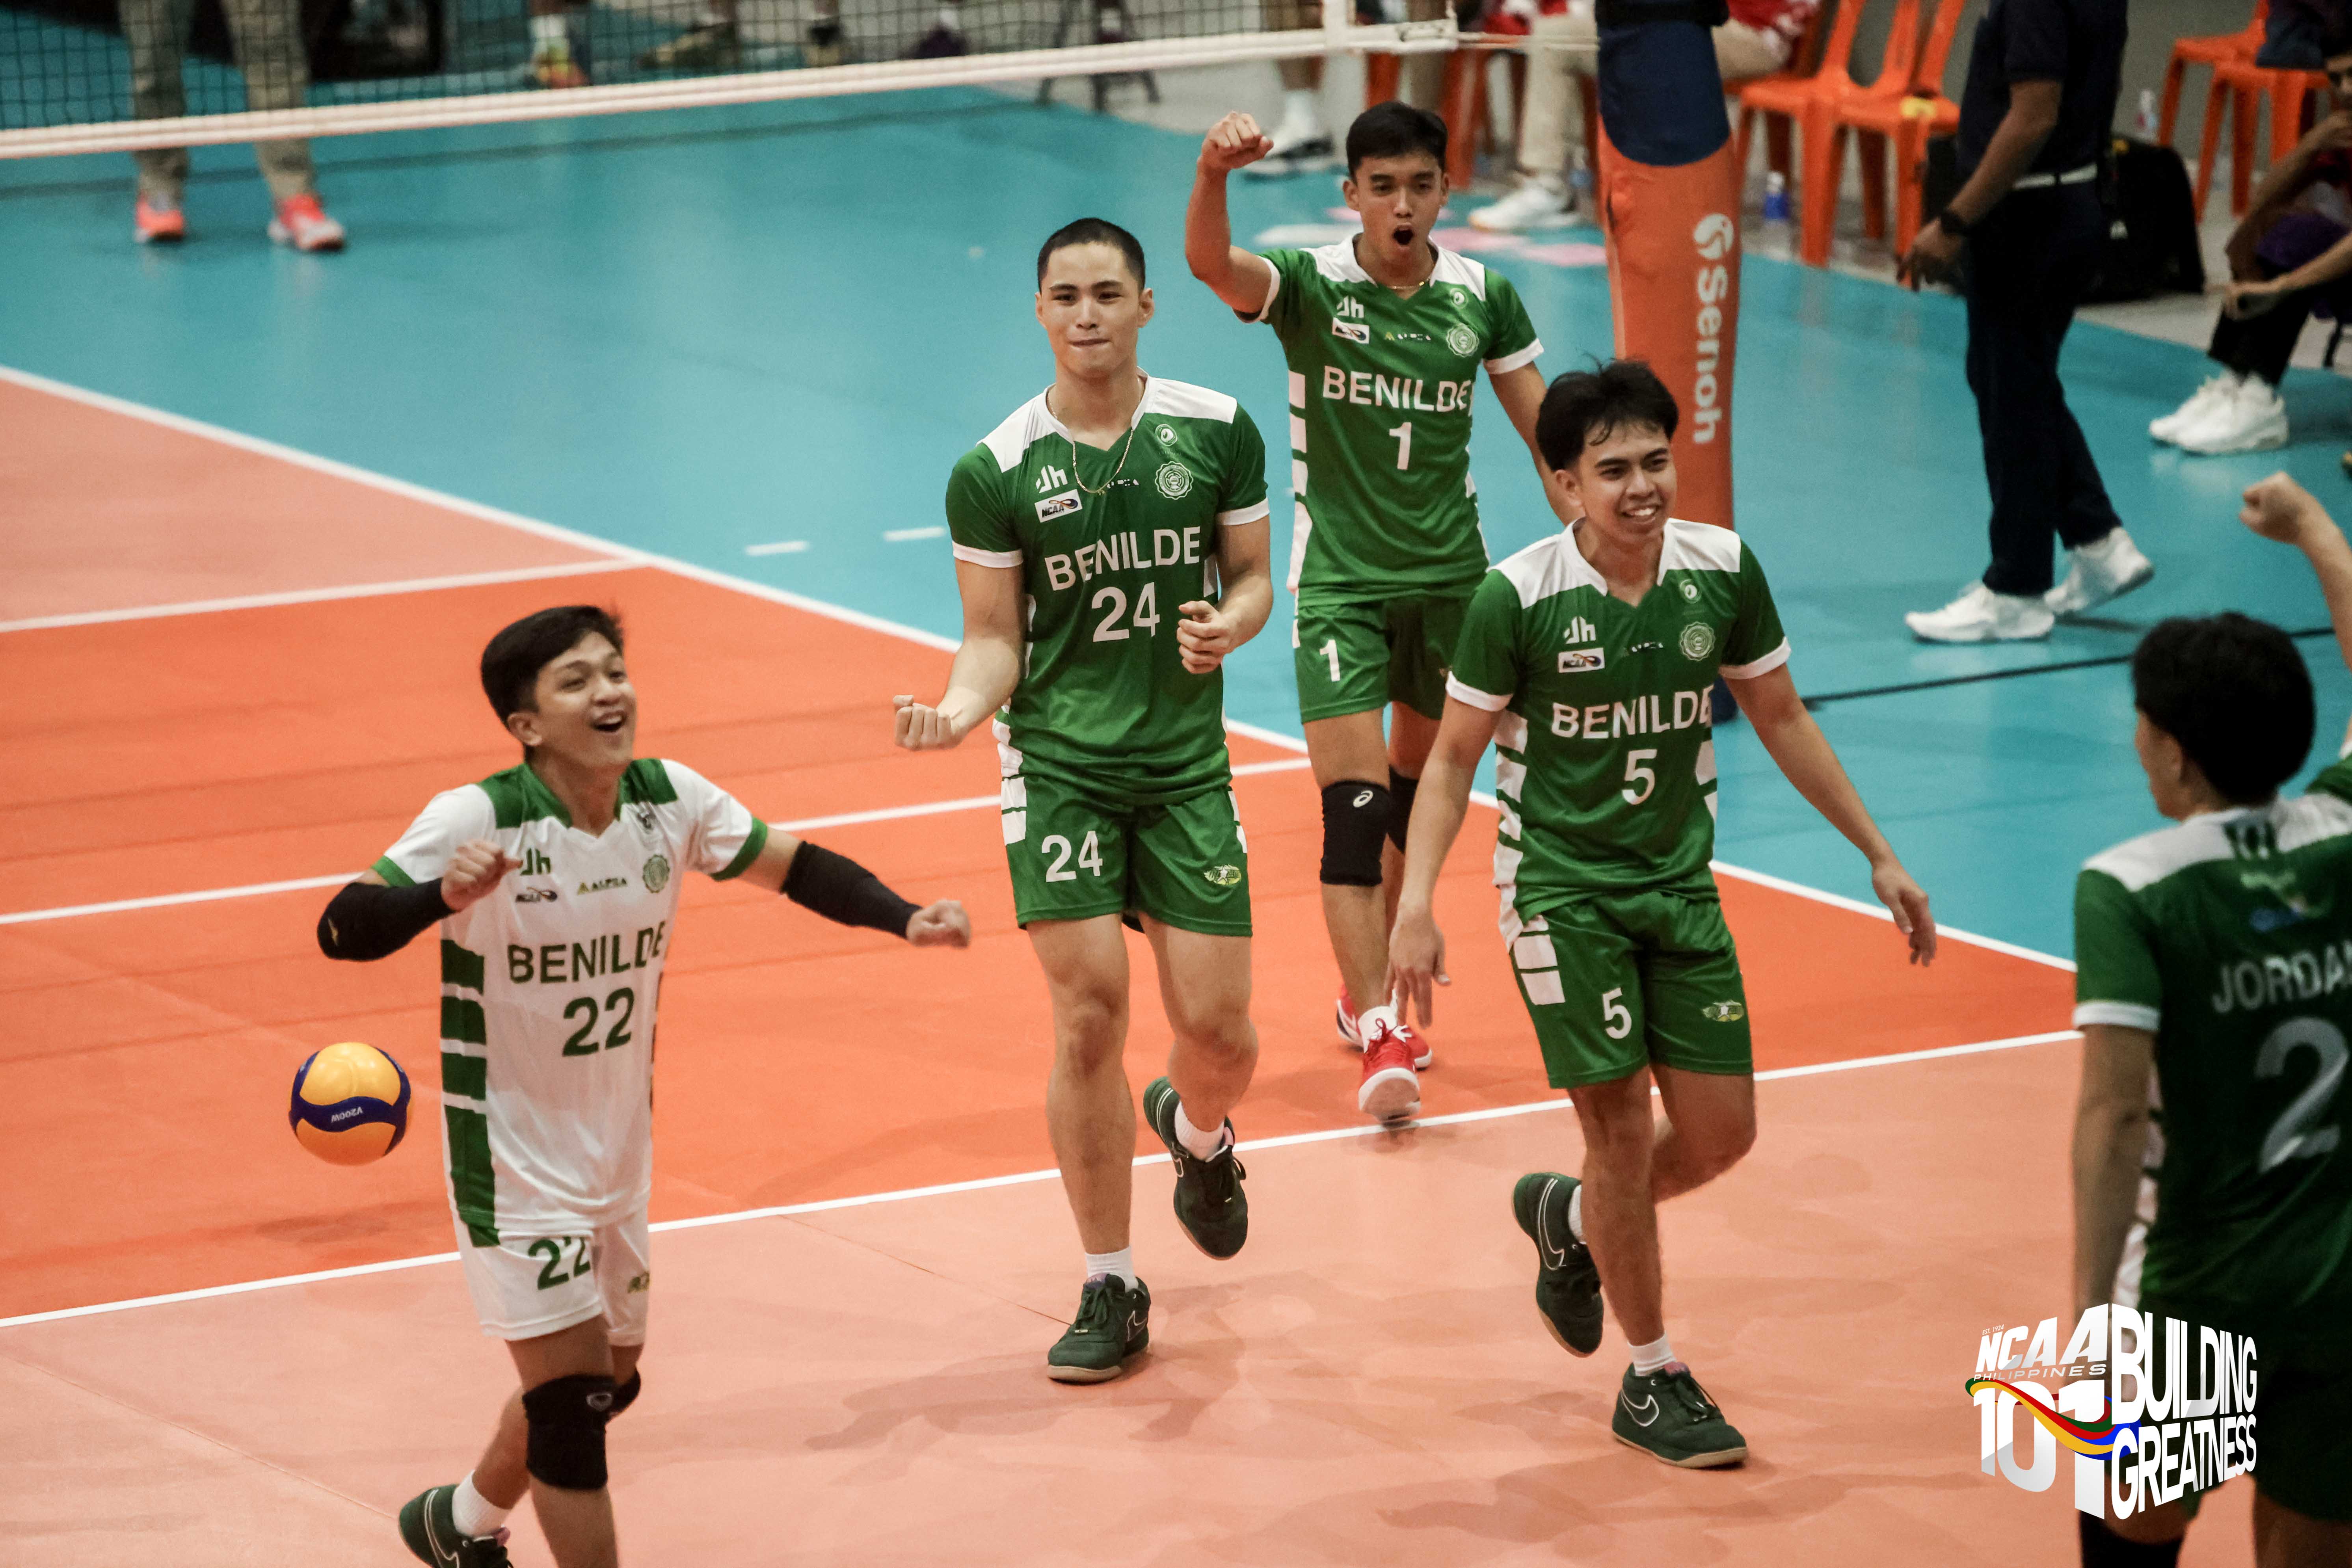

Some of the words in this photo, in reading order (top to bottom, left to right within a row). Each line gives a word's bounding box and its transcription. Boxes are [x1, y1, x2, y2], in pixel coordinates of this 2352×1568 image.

[1693, 265, 1728, 444] Senoh
[1323, 366, 1471, 413] BENILDE
[1389, 422, 1411, 470] 1
[1045, 526, 1201, 591] BENILDE
[1092, 582, 1160, 642] 24
[1319, 639, 1340, 682] 1
[1551, 684, 1714, 739] BENILDE
[1622, 749, 1658, 805] 5
[1042, 831, 1103, 882] 24
[508, 921, 666, 984] BENILDE
[562, 987, 635, 1057] 22
[1602, 988, 1632, 1039] 5
[2254, 1017, 2349, 1174] 2
[528, 1236, 591, 1290] 22
